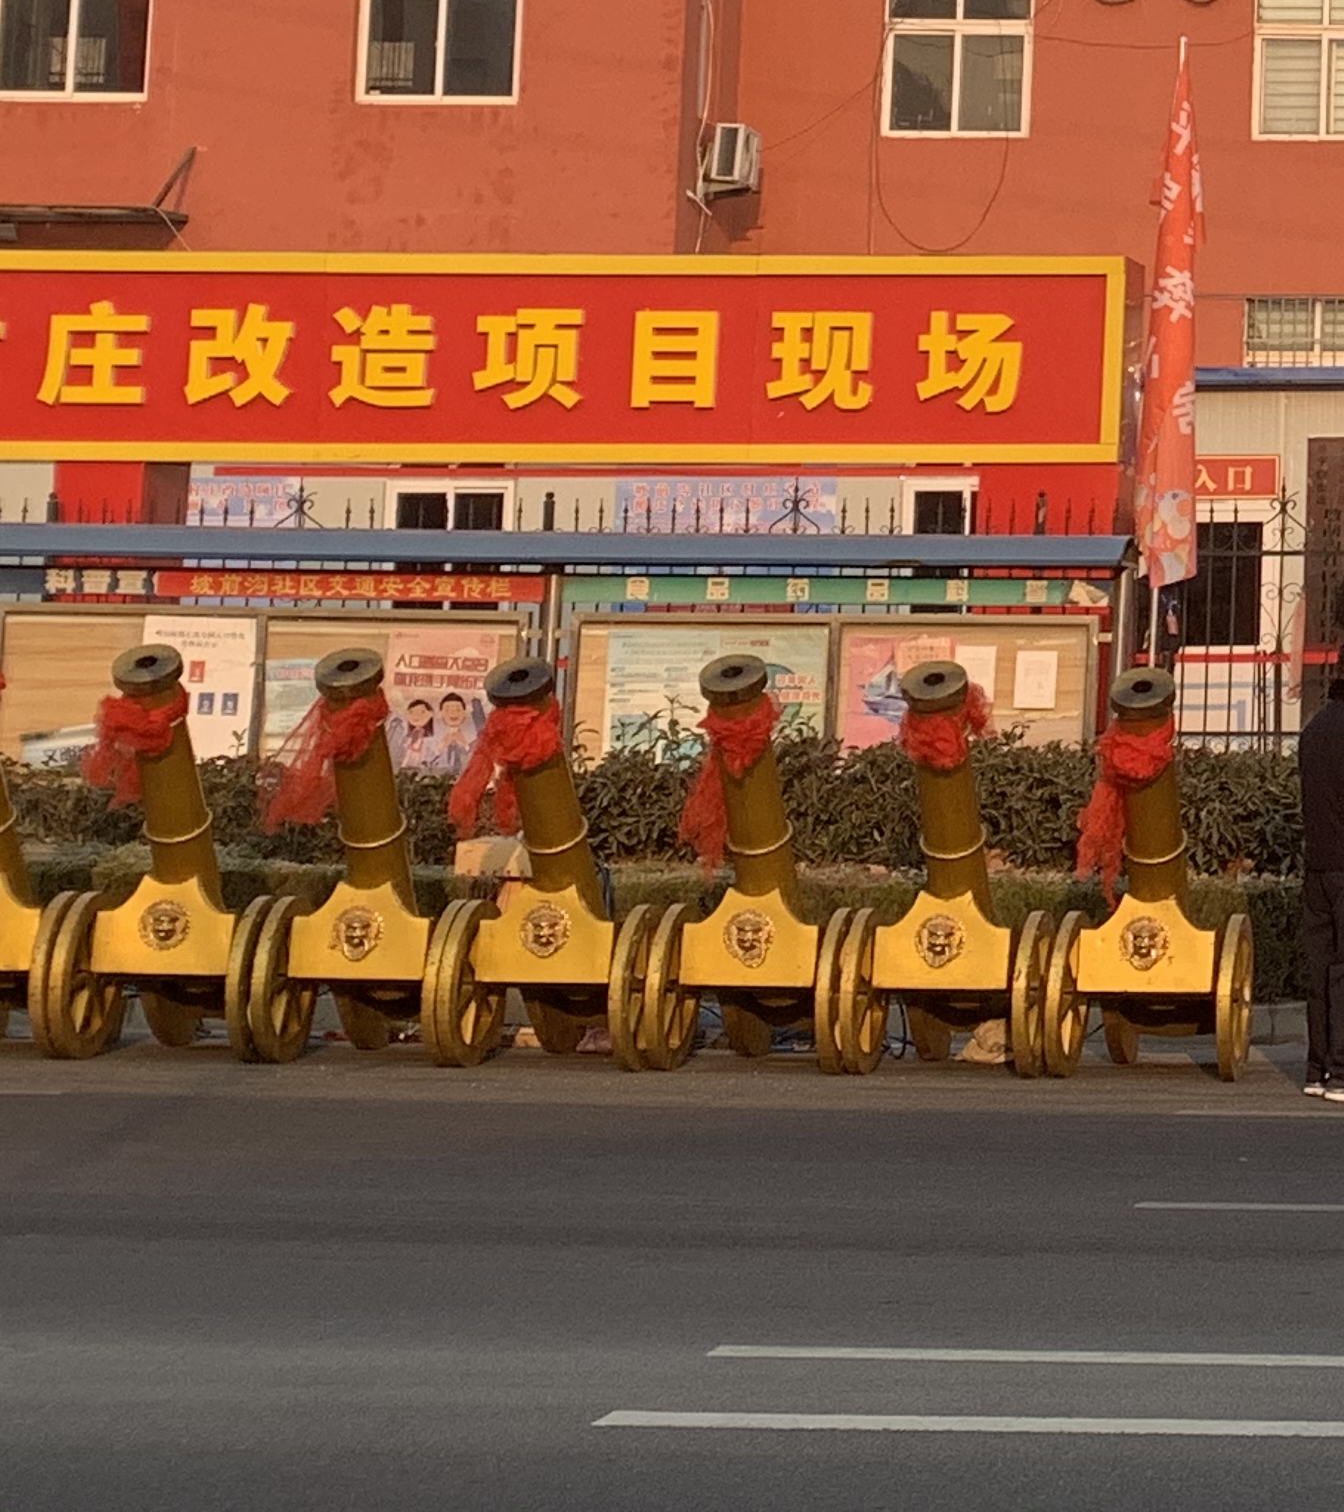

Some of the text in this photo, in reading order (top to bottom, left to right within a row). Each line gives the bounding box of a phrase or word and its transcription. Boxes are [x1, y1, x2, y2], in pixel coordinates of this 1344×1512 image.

[0, 300, 1025, 413] 庄改造项目现场
[1194, 464, 1253, 493] 入口
[189, 574, 512, 599] 坡前沟社区交通安全宣传栏
